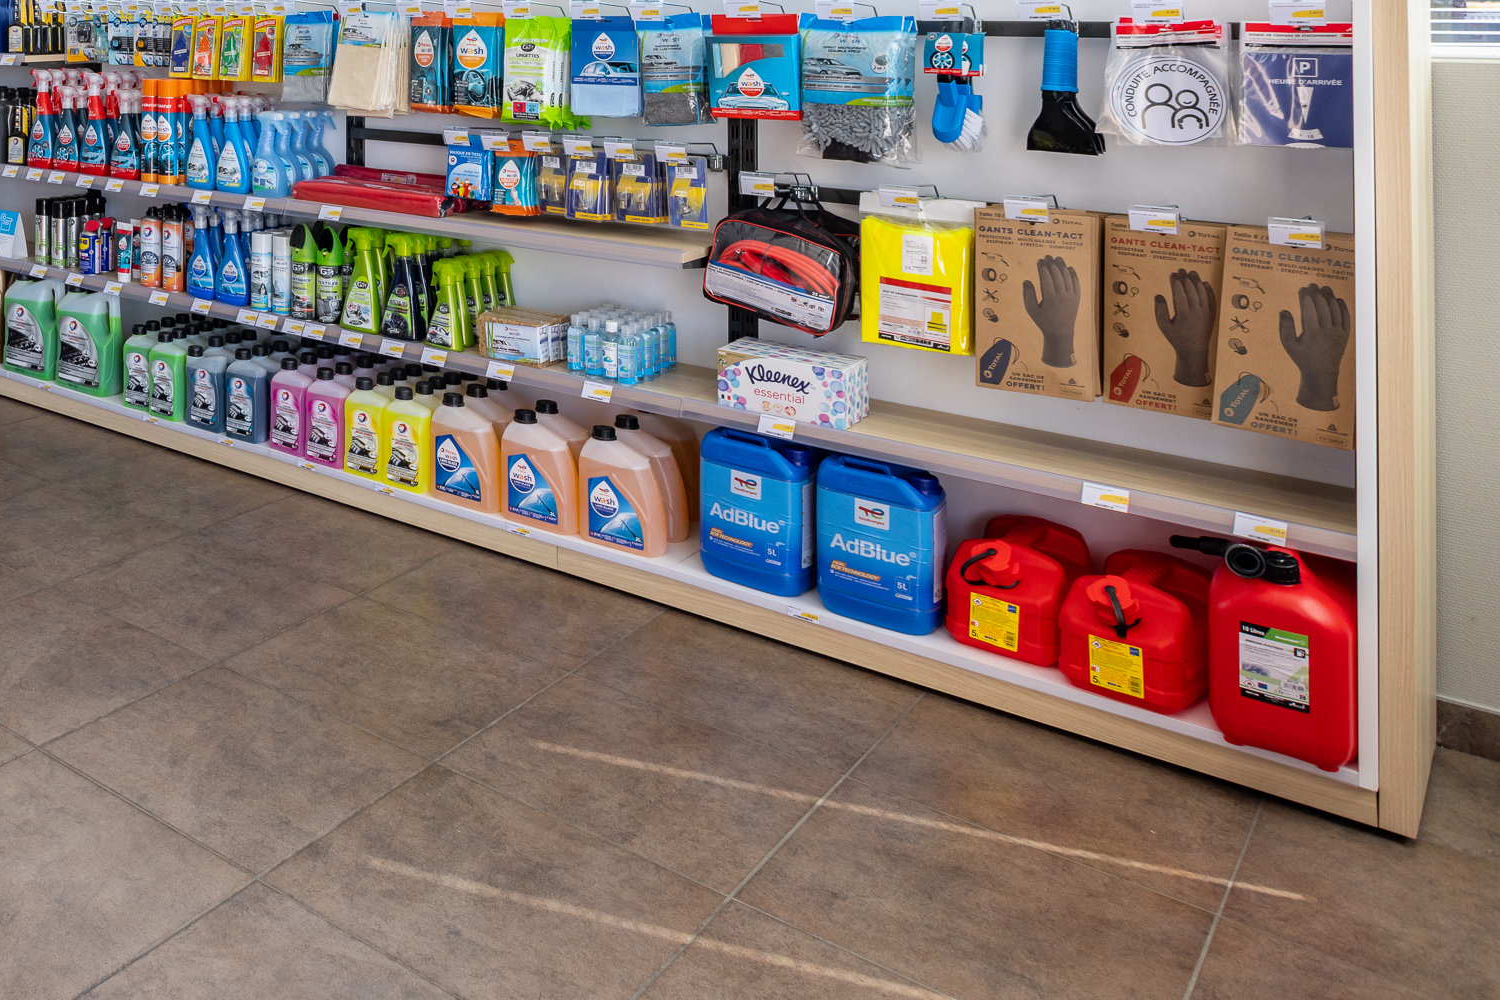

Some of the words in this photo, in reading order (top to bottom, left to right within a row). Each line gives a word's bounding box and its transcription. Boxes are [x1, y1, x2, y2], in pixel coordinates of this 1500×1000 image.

[460, 46, 484, 55] wash
[1300, 61, 1310, 73] P
[1298, 77, 1343, 86] D'ARRIVÉE
[1125, 70, 1151, 117] CONDUITE
[1153, 63, 1220, 115] ACCOMPAGNÉE
[979, 226, 1013, 234] GANTS
[1017, 229, 1083, 240] CLEAN-TACT
[1111, 237, 1146, 247] GANTS
[1150, 240, 1221, 254] CLEAN-TACT
[1150, 250, 1191, 258] MULTI-USAGES
[1232, 246, 1274, 259] GANTS
[1231, 256, 1272, 265] PROTECTEUR
[1277, 262, 1324, 272] MULTI-USAGES
[1240, 262, 1274, 271] RESPIRANT
[1315, 272, 1349, 281] CONFORT
[988, 352, 1003, 370] TOTAL
[745, 364, 811, 395] Kleenex
[1009, 376, 1044, 384] RANGEMENT
[1119, 368, 1133, 388] TOTAL
[754, 388, 805, 405] essential
[1138, 394, 1177, 403] RANGEMENT
[1231, 388, 1250, 409] TOTAL
[1254, 415, 1298, 428] RANGEMENT
[513, 472, 532, 482] wash
[594, 495, 615, 506] wash
[710, 502, 780, 534] AdBlue
[859, 516, 885, 525] TotalEnergies
[720, 534, 752, 547] TECHNOLOGY
[767, 548, 777, 557] 5L
[830, 533, 910, 567] AdBlue
[842, 566, 880, 581] TECHNOLOGY
[897, 582, 908, 591] 5L
[1250, 627, 1265, 636] Litres
